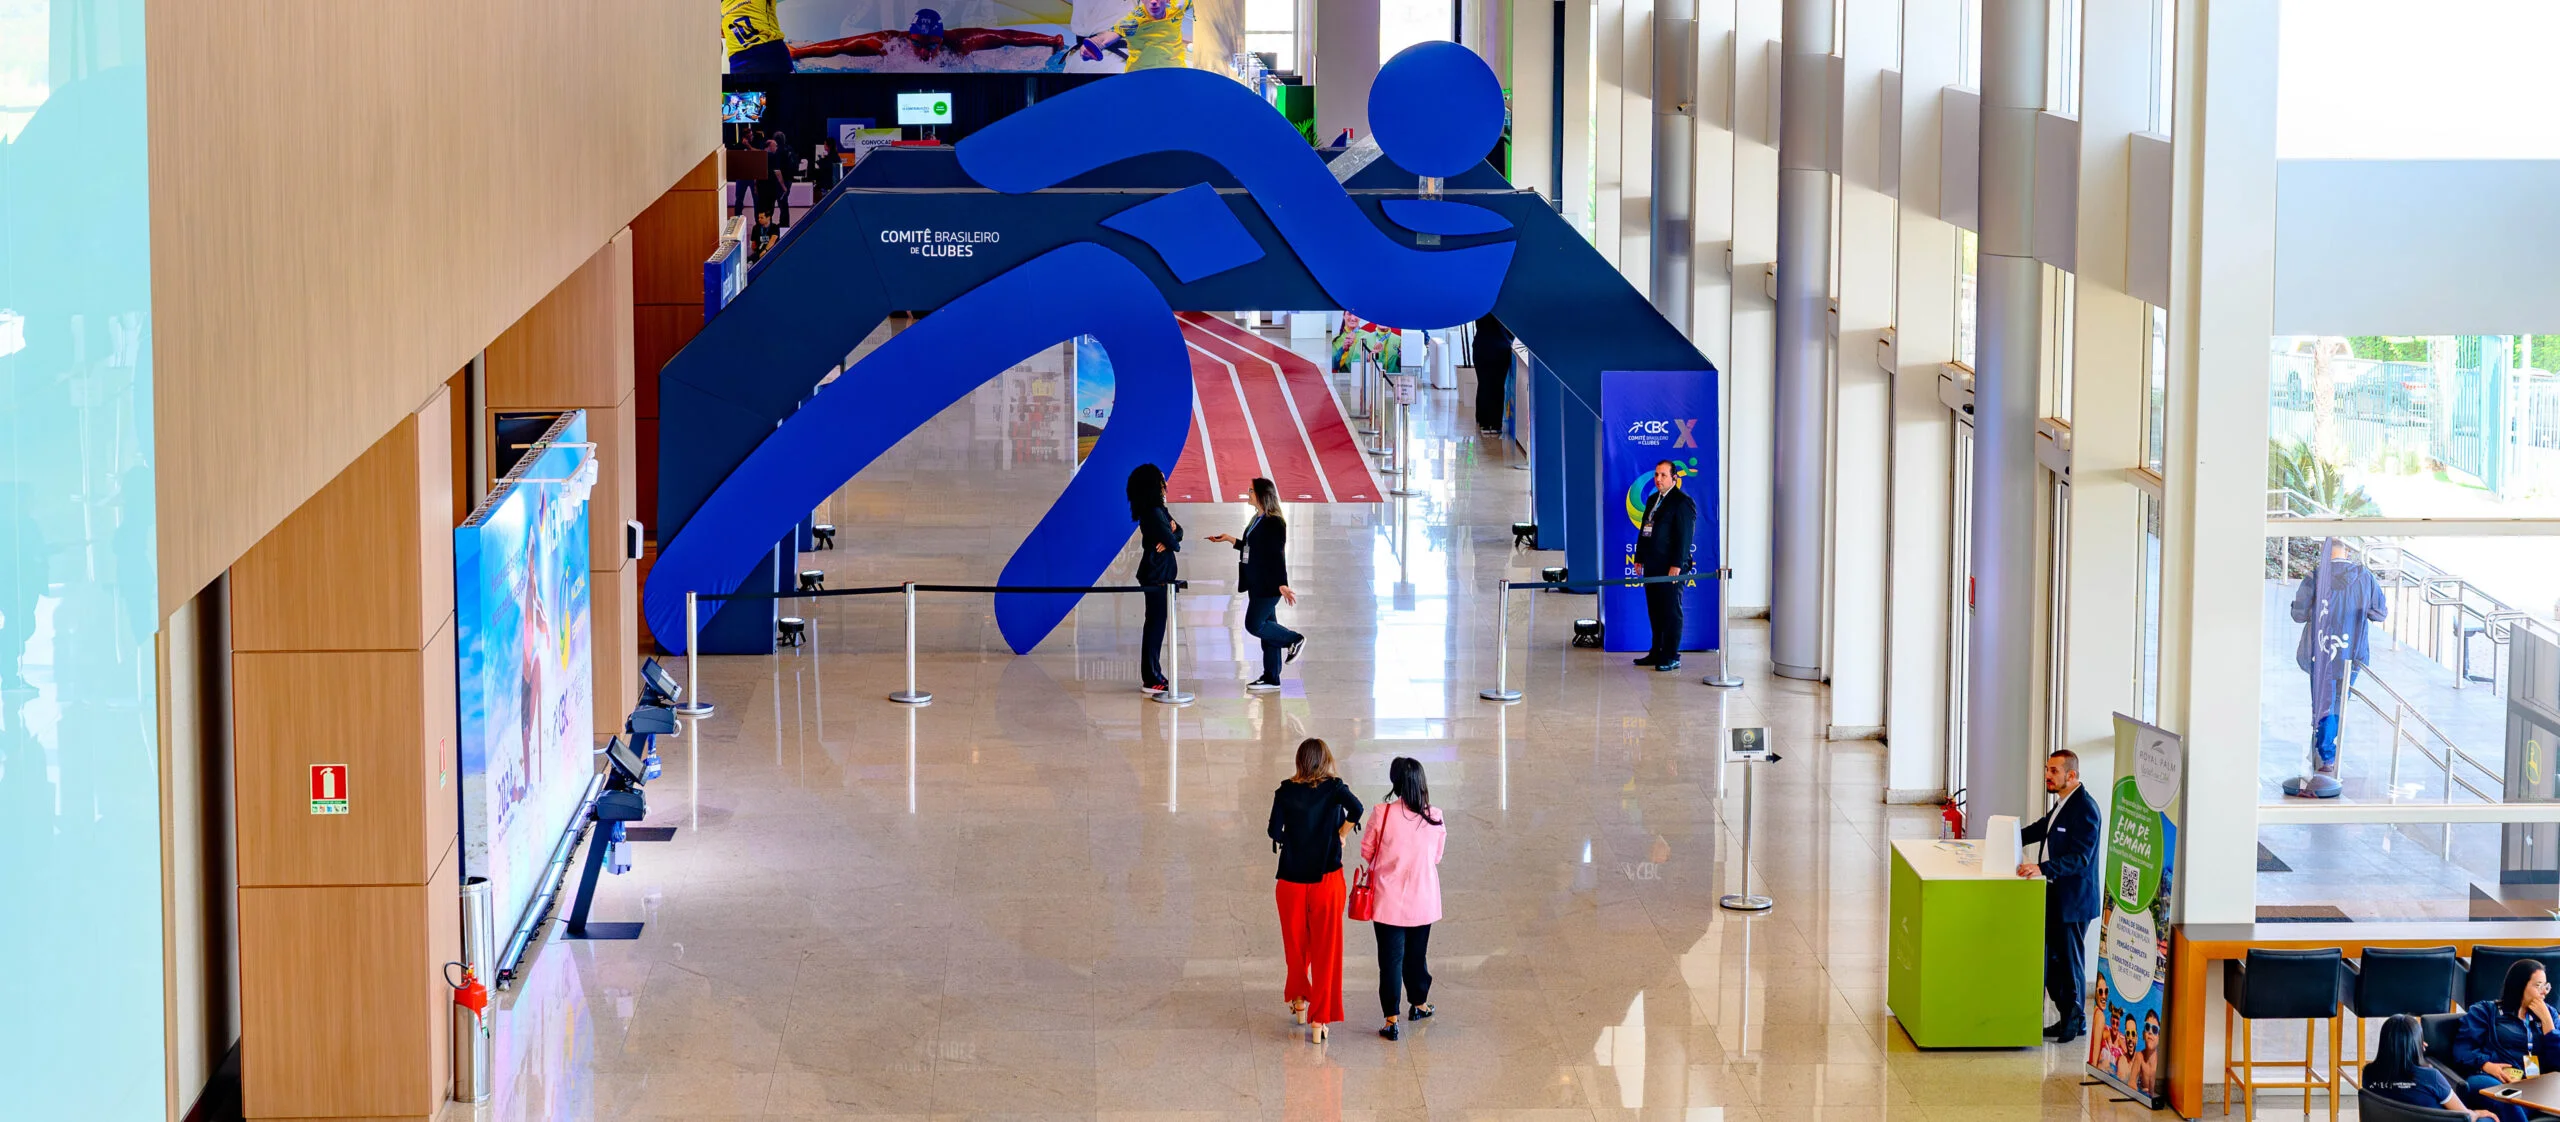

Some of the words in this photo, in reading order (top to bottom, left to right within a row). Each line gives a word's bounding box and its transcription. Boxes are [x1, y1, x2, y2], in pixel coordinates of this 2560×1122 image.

[881, 228, 931, 243] COMITÊ
[935, 231, 1000, 243] BRASILEIRO
[922, 244, 973, 257] CLUBES
[1644, 420, 1669, 434] CBC
[1673, 419, 1698, 448] X
[2140, 750, 2158, 766] ROYAL
[2160, 760, 2176, 773] PALM
[2117, 814, 2136, 835] FIM
[2137, 823, 2150, 841] DE
[2113, 830, 2152, 860] SEMANA
